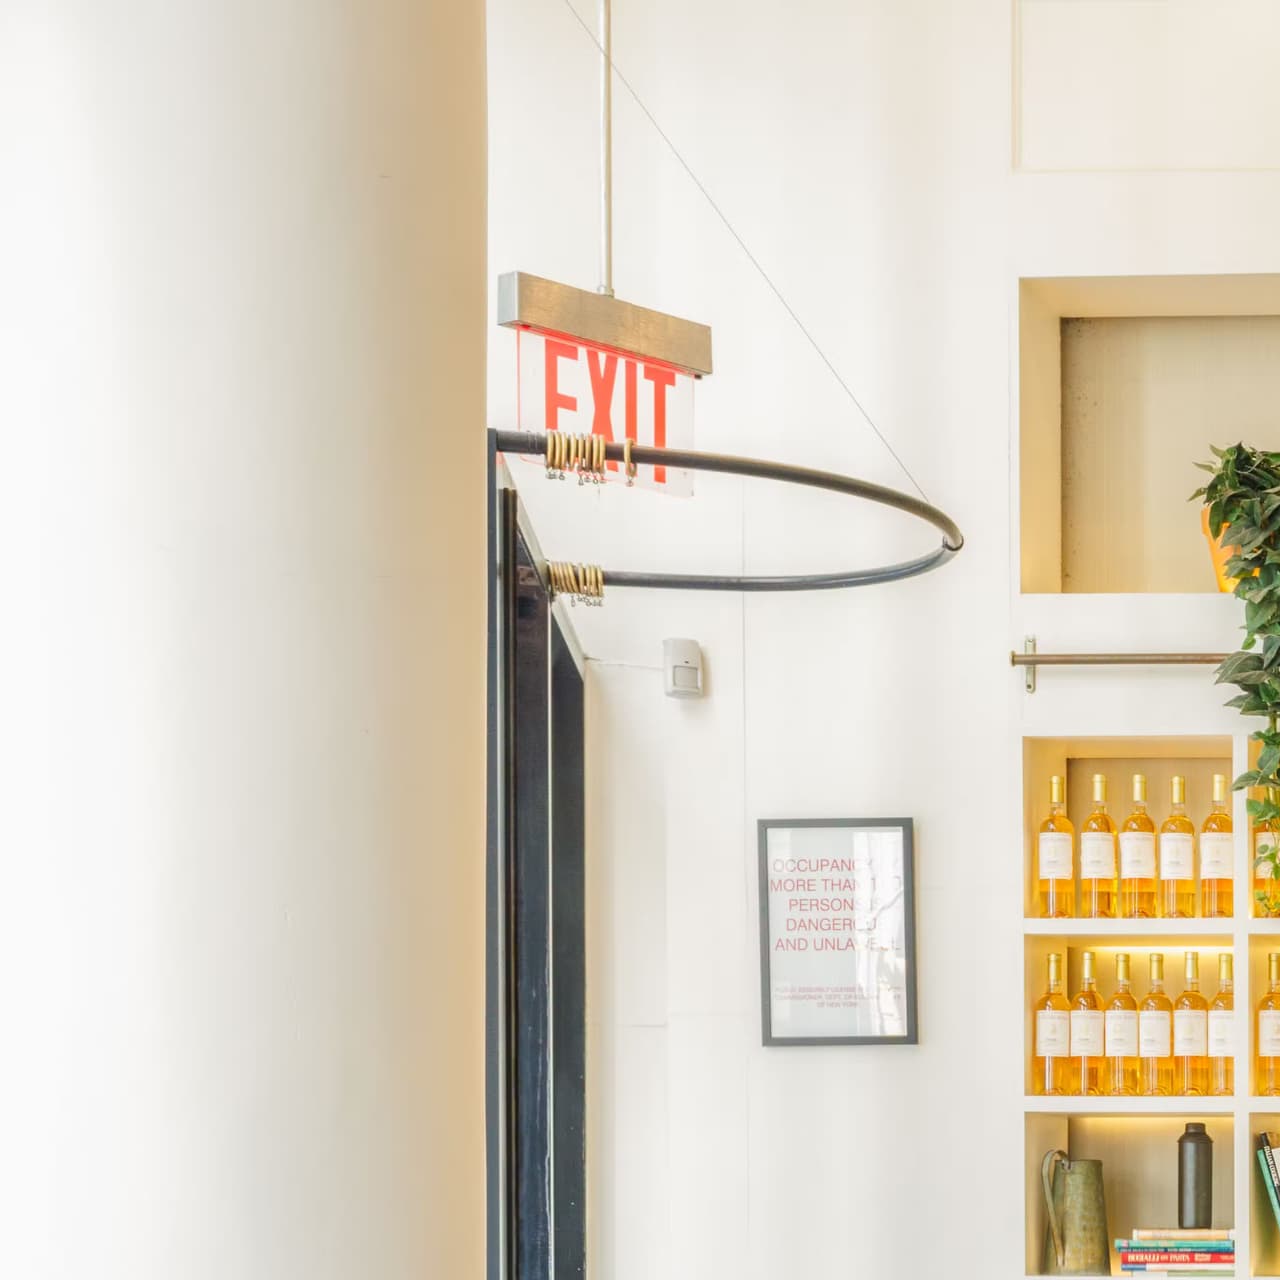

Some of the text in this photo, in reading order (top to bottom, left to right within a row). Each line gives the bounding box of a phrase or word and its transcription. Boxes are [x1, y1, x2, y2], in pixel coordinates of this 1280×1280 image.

[545, 338, 676, 484] EXIT
[772, 858, 856, 873] OCCUPAN
[770, 878, 816, 892] MORE
[789, 898, 855, 912] PERSON
[786, 918, 857, 932] DANGER
[775, 937, 808, 951] AND
